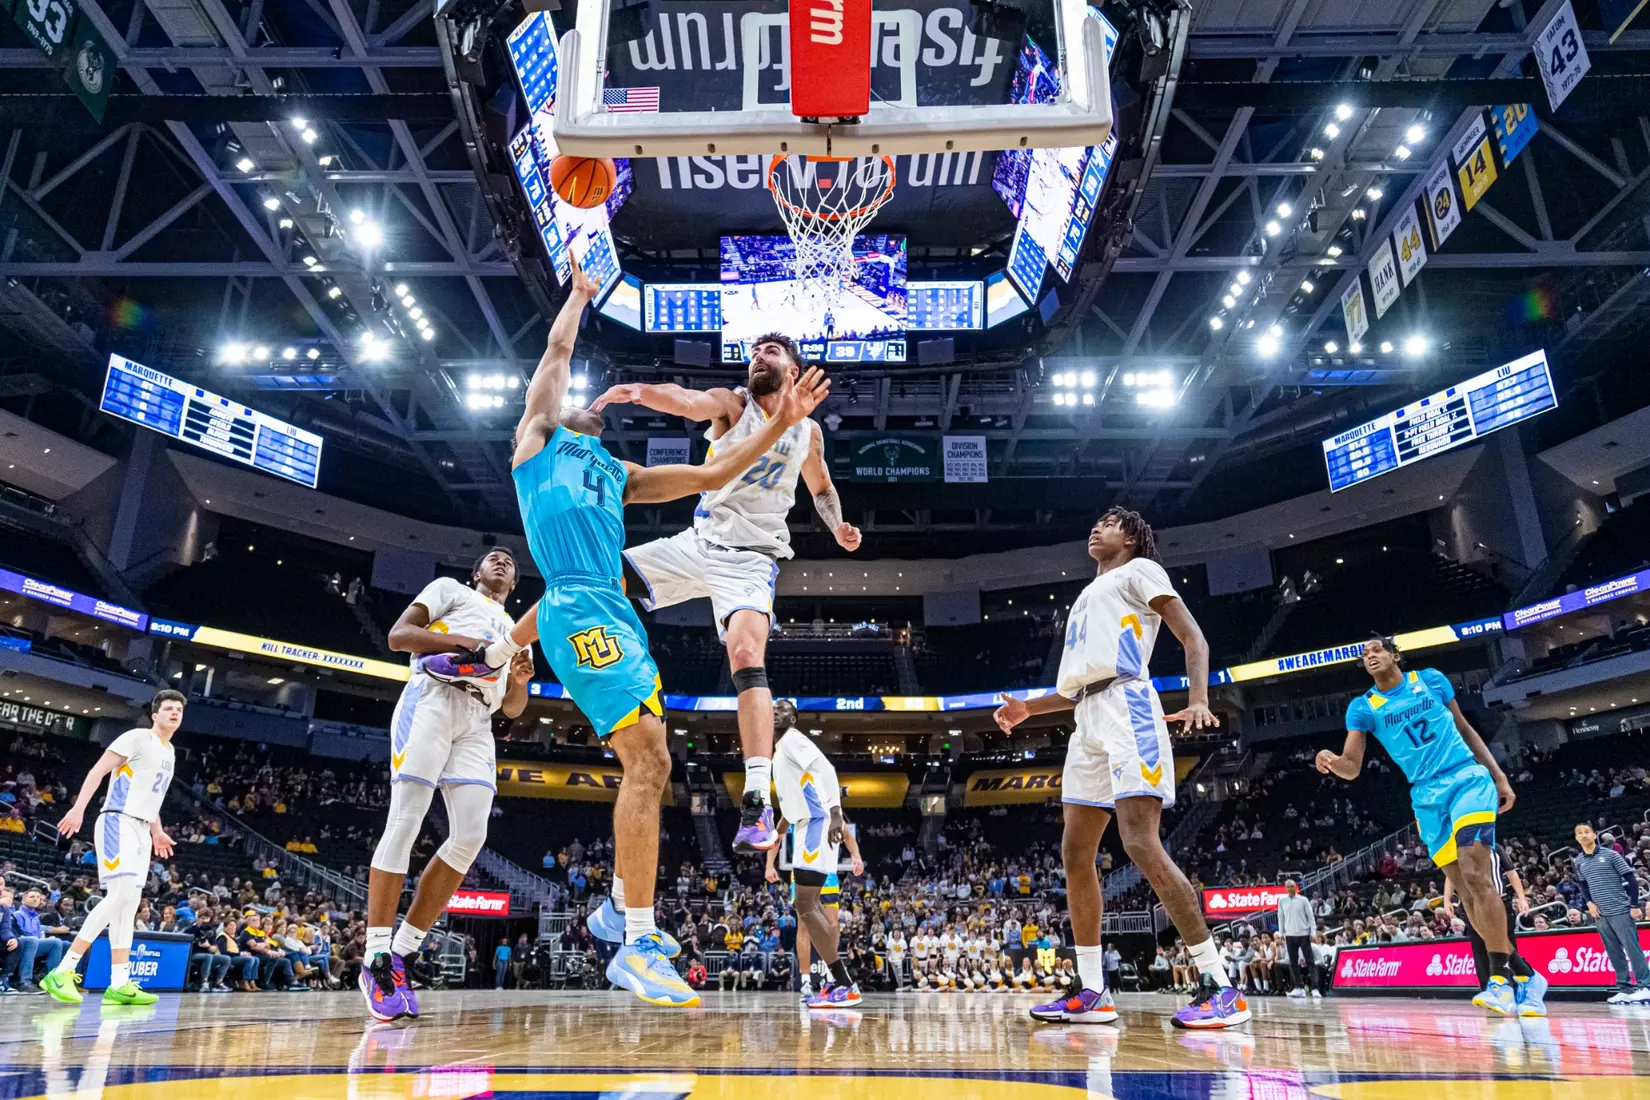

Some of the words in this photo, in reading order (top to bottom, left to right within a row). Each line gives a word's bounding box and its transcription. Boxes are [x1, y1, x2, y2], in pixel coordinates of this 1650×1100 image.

[1546, 15, 1566, 42] TATUM
[1551, 28, 1579, 77] 43
[1464, 148, 1487, 187] 14
[1436, 189, 1450, 218] 24
[1401, 224, 1421, 263] 44
[1374, 259, 1394, 294] HANK
[835, 345, 855, 357] 39
[124, 361, 174, 388] MARQUETTE
[1496, 365, 1511, 378] LIU
[1334, 422, 1376, 446] MARQUETTE
[1418, 420, 1435, 433] FIELD
[650, 448, 688, 456] CONFERENCE
[947, 451, 984, 459] CHAMPIONS
[951, 441, 978, 450] DIVISION
[556, 440, 624, 484] Marquette
[856, 467, 883, 476] WORLD
[885, 466, 930, 476] CHAMPIONS
[742, 456, 787, 489] 20
[583, 469, 605, 507] 4
[23, 578, 74, 598] CleanPower
[1585, 576, 1636, 596] CleanPower
[96, 600, 140, 618] CleanPower
[1514, 599, 1560, 618] CleanPower
[173, 626, 190, 637] PM
[1065, 614, 1087, 649] 44
[1484, 620, 1502, 631] PM
[261, 642, 278, 653] KILL
[281, 645, 321, 661] TRACKER:
[567, 625, 624, 670] MU
[1278, 642, 1367, 672] #WEAREMARQU
[1218, 671, 1225, 683] 1
[531, 684, 541, 695] 3
[836, 697, 864, 710] 2nd
[1384, 697, 1435, 728] Marquette
[22, 706, 44, 724] THE
[1404, 718, 1437, 748] 12
[1572, 724, 1600, 735] Hennessy
[566, 772, 623, 788] AR
[1443, 953, 1477, 976] State
